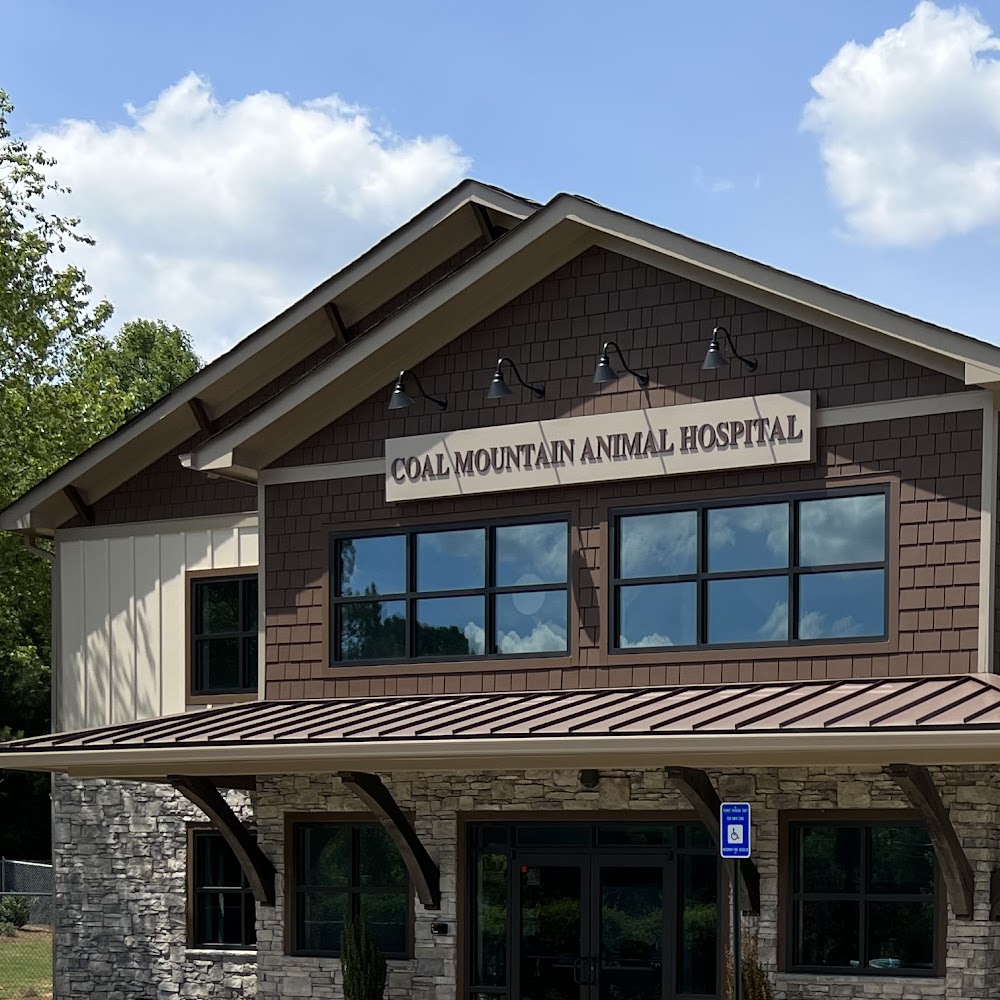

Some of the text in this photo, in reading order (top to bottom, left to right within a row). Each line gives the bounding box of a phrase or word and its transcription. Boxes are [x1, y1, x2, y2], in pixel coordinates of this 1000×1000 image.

[391, 415, 803, 482] COAL MOUNTAIN ANIMAL HOSPITAL
